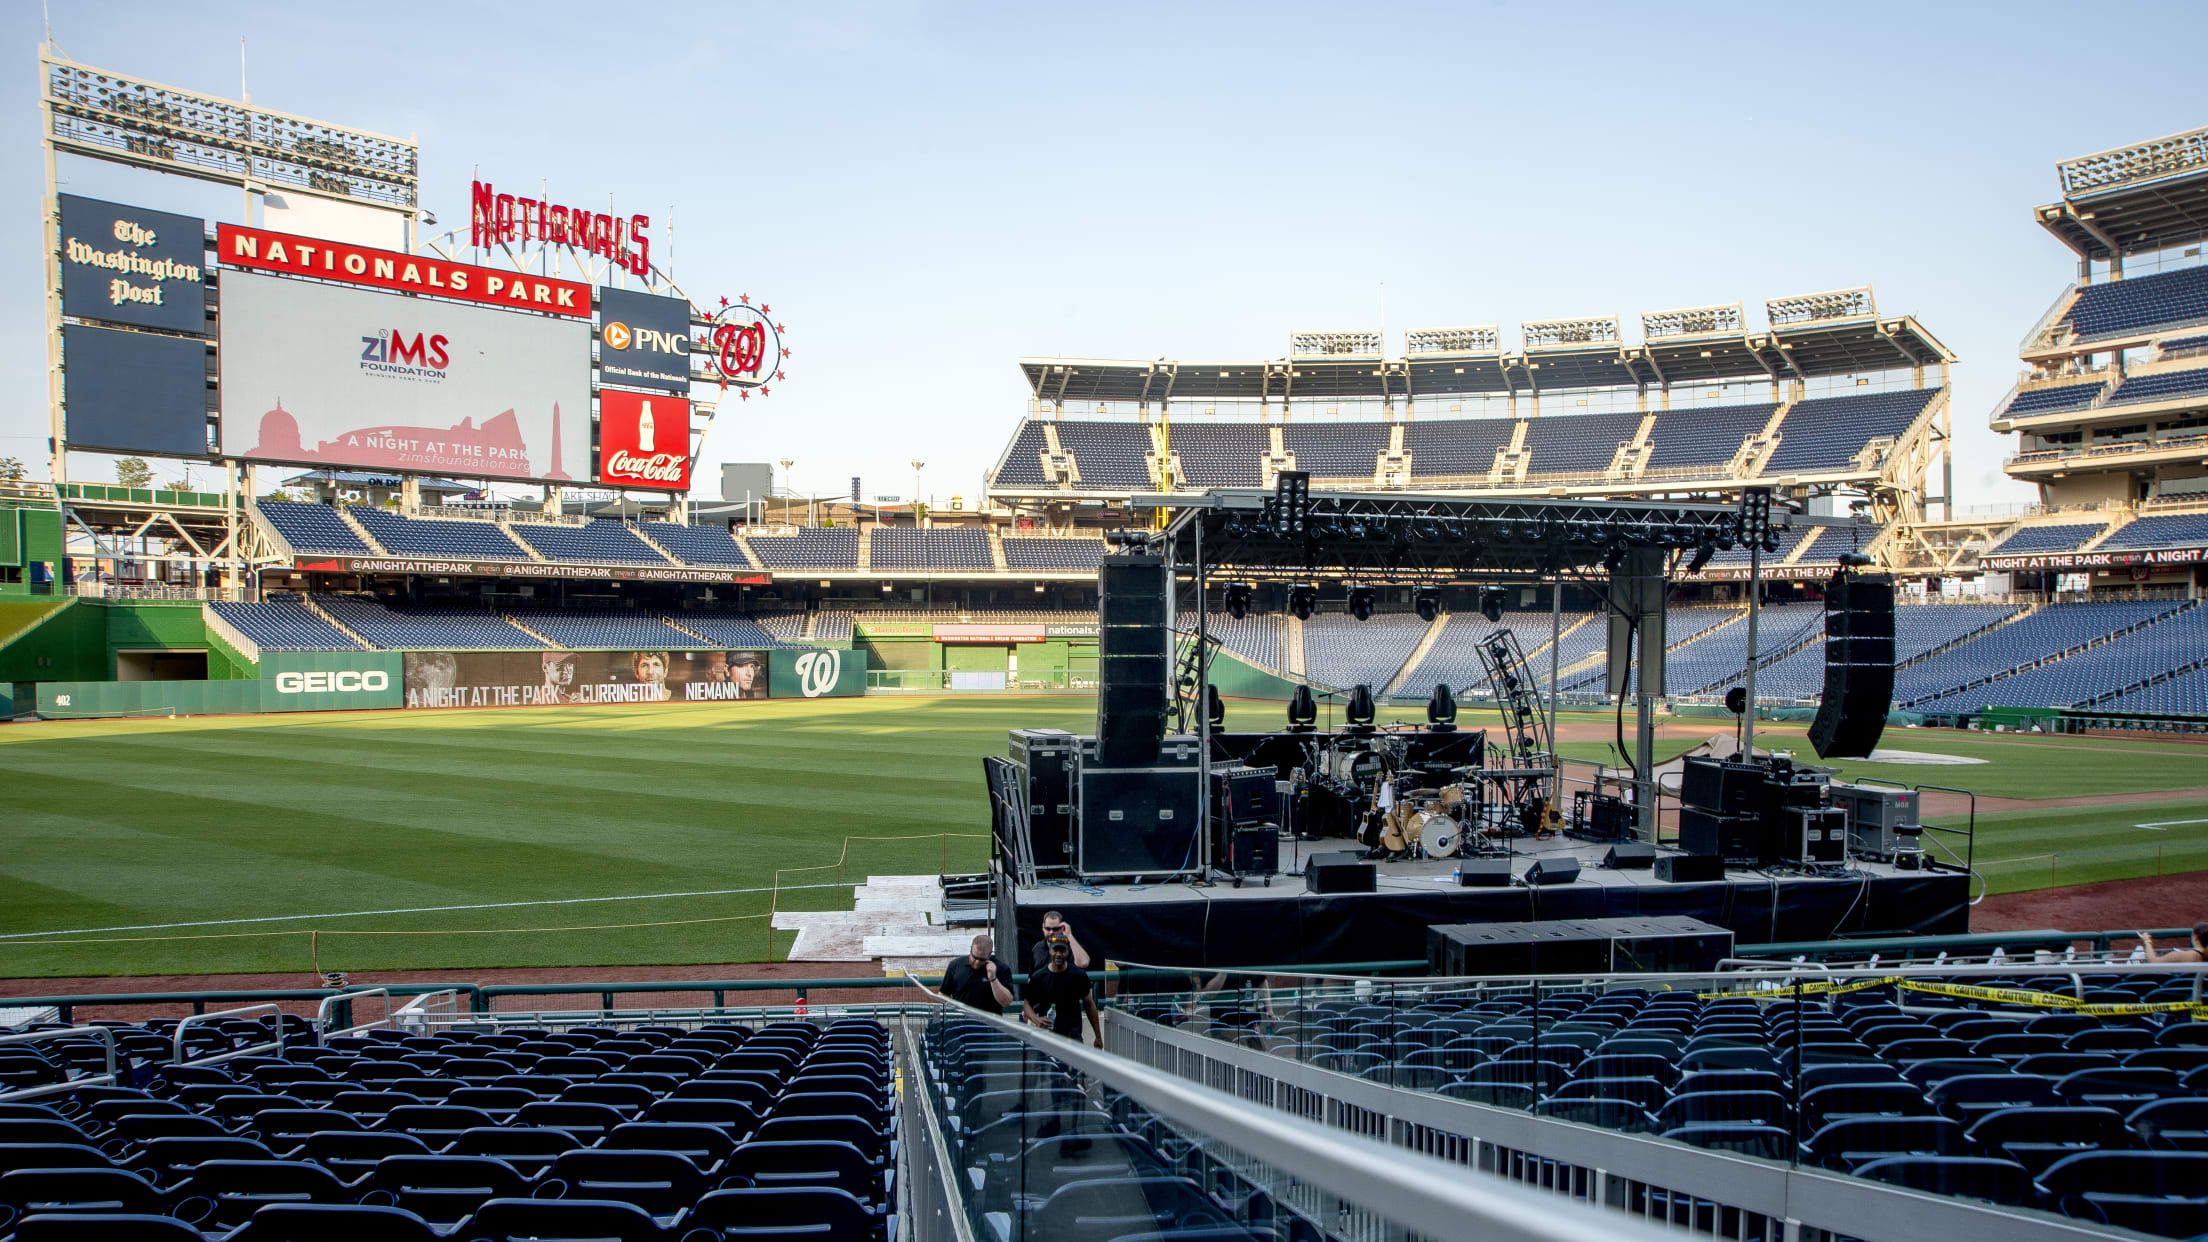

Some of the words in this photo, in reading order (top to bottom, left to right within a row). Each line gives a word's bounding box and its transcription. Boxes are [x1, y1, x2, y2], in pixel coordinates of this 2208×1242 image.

[114, 219, 158, 247] The
[471, 180, 650, 275] NATIONALS
[66, 237, 201, 282] Washington
[235, 235, 468, 291] NATIONALS
[488, 276, 576, 308] PARK
[110, 278, 164, 306] Post
[632, 327, 689, 356] PNC
[360, 362, 446, 379] FOUNDATION
[604, 365, 627, 375] Official
[627, 368, 643, 377] Bank
[660, 372, 687, 383] Nationals
[348, 435, 359, 447] A
[366, 436, 420, 452] NIGHT
[425, 442, 446, 454] AT
[452, 444, 483, 457] THE
[489, 447, 529, 460] PARK
[398, 452, 530, 473] zimsfoundation.org
[368, 478, 383, 487] ON
[1980, 559, 1989, 569] A
[1990, 557, 2028, 569] NIGHT
[2029, 557, 2047, 568] AT
[2049, 555, 2073, 567] THE
[2075, 554, 2112, 566] PARK
[2144, 551, 2155, 563] A
[2157, 549, 2202, 562] NIGHT
[351, 559, 472, 574] @ANIGHTATTHEPARK
[504, 563, 611, 578] @ANIGHTATTHEPARK
[638, 569, 733, 581] @ANIGHTATTHEPARK
[1733, 570, 1742, 579] A
[1776, 568, 1792, 578] AT
[1793, 567, 1814, 577] THE
[1048, 625, 1101, 635] nationals.c
[275, 670, 389, 693] GEICO
[55, 695, 71, 706] 402
[408, 687, 420, 709] A
[422, 686, 468, 708] NIGHT
[471, 686, 490, 707] AT
[493, 685, 520, 706] THE
[522, 684, 561, 705] PARK
[580, 682, 664, 703] CURRINGTON
[685, 681, 740, 701] NIEMANN
[1914, 982, 1947, 993] CAUTION
[1953, 985, 1989, 998] CAUTION
[1996, 990, 2033, 1003] CAUTION
